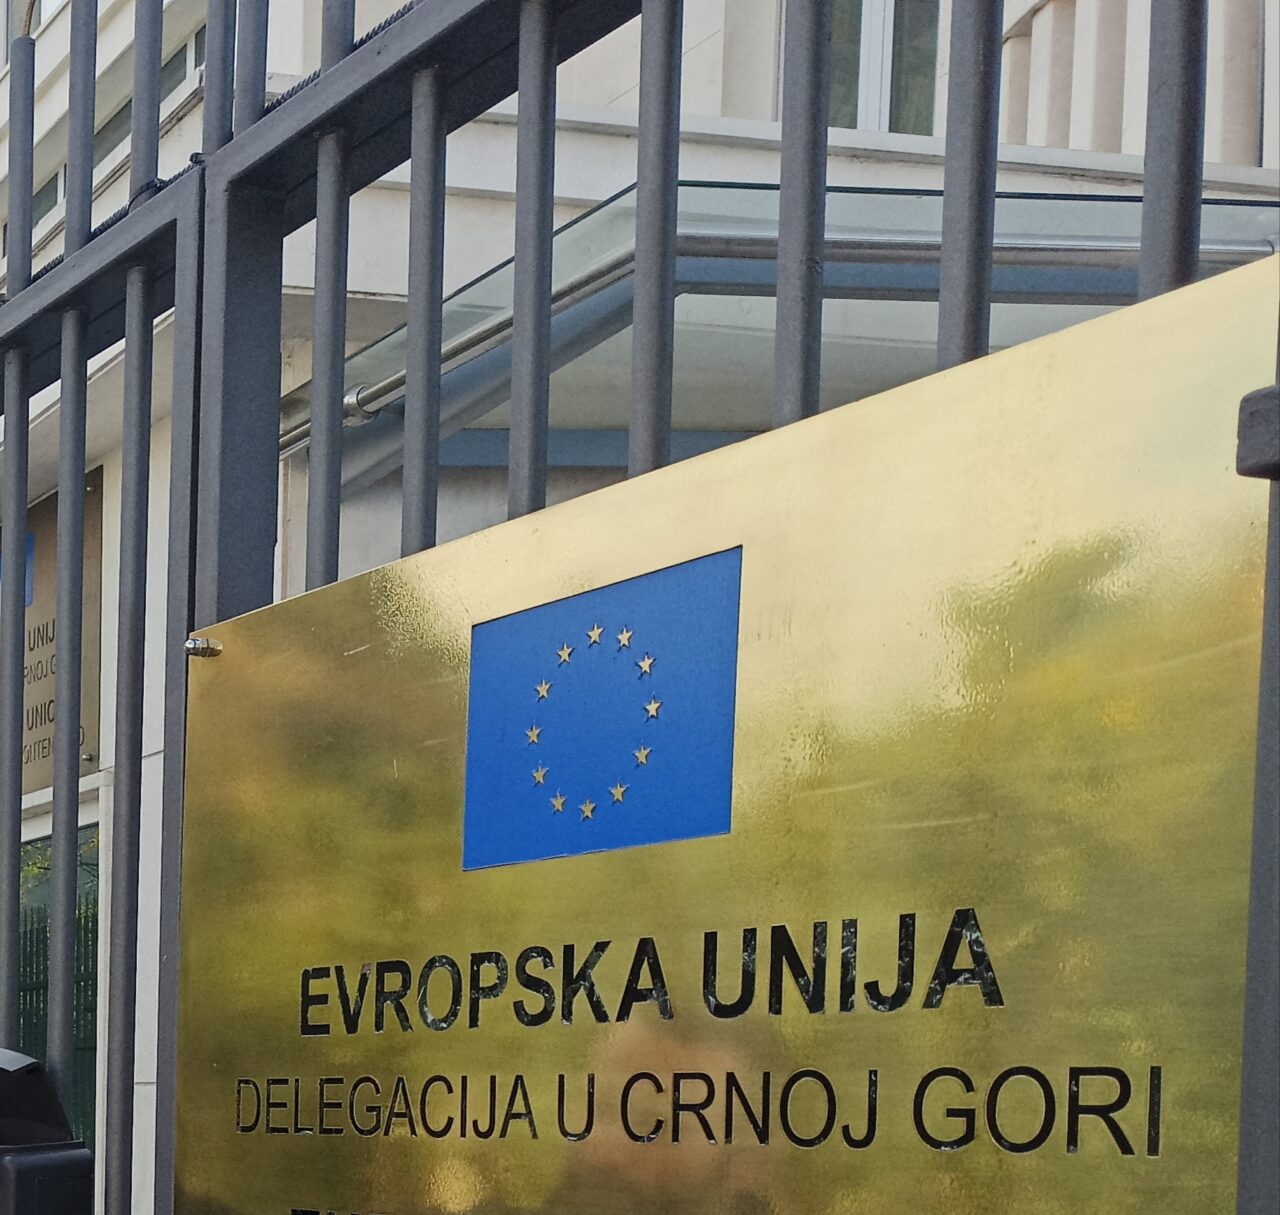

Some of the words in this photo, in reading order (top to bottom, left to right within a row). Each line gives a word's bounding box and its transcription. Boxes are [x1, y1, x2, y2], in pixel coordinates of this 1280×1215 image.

[28, 617, 56, 652] UNIJ
[300, 937, 674, 1036] EVROPSKA
[703, 908, 1005, 1019] UNIJA
[235, 1072, 539, 1140] DELEGACIJA
[558, 1073, 595, 1142] U
[620, 1068, 880, 1149] CRNOJ
[913, 1065, 1163, 1157] GORI
